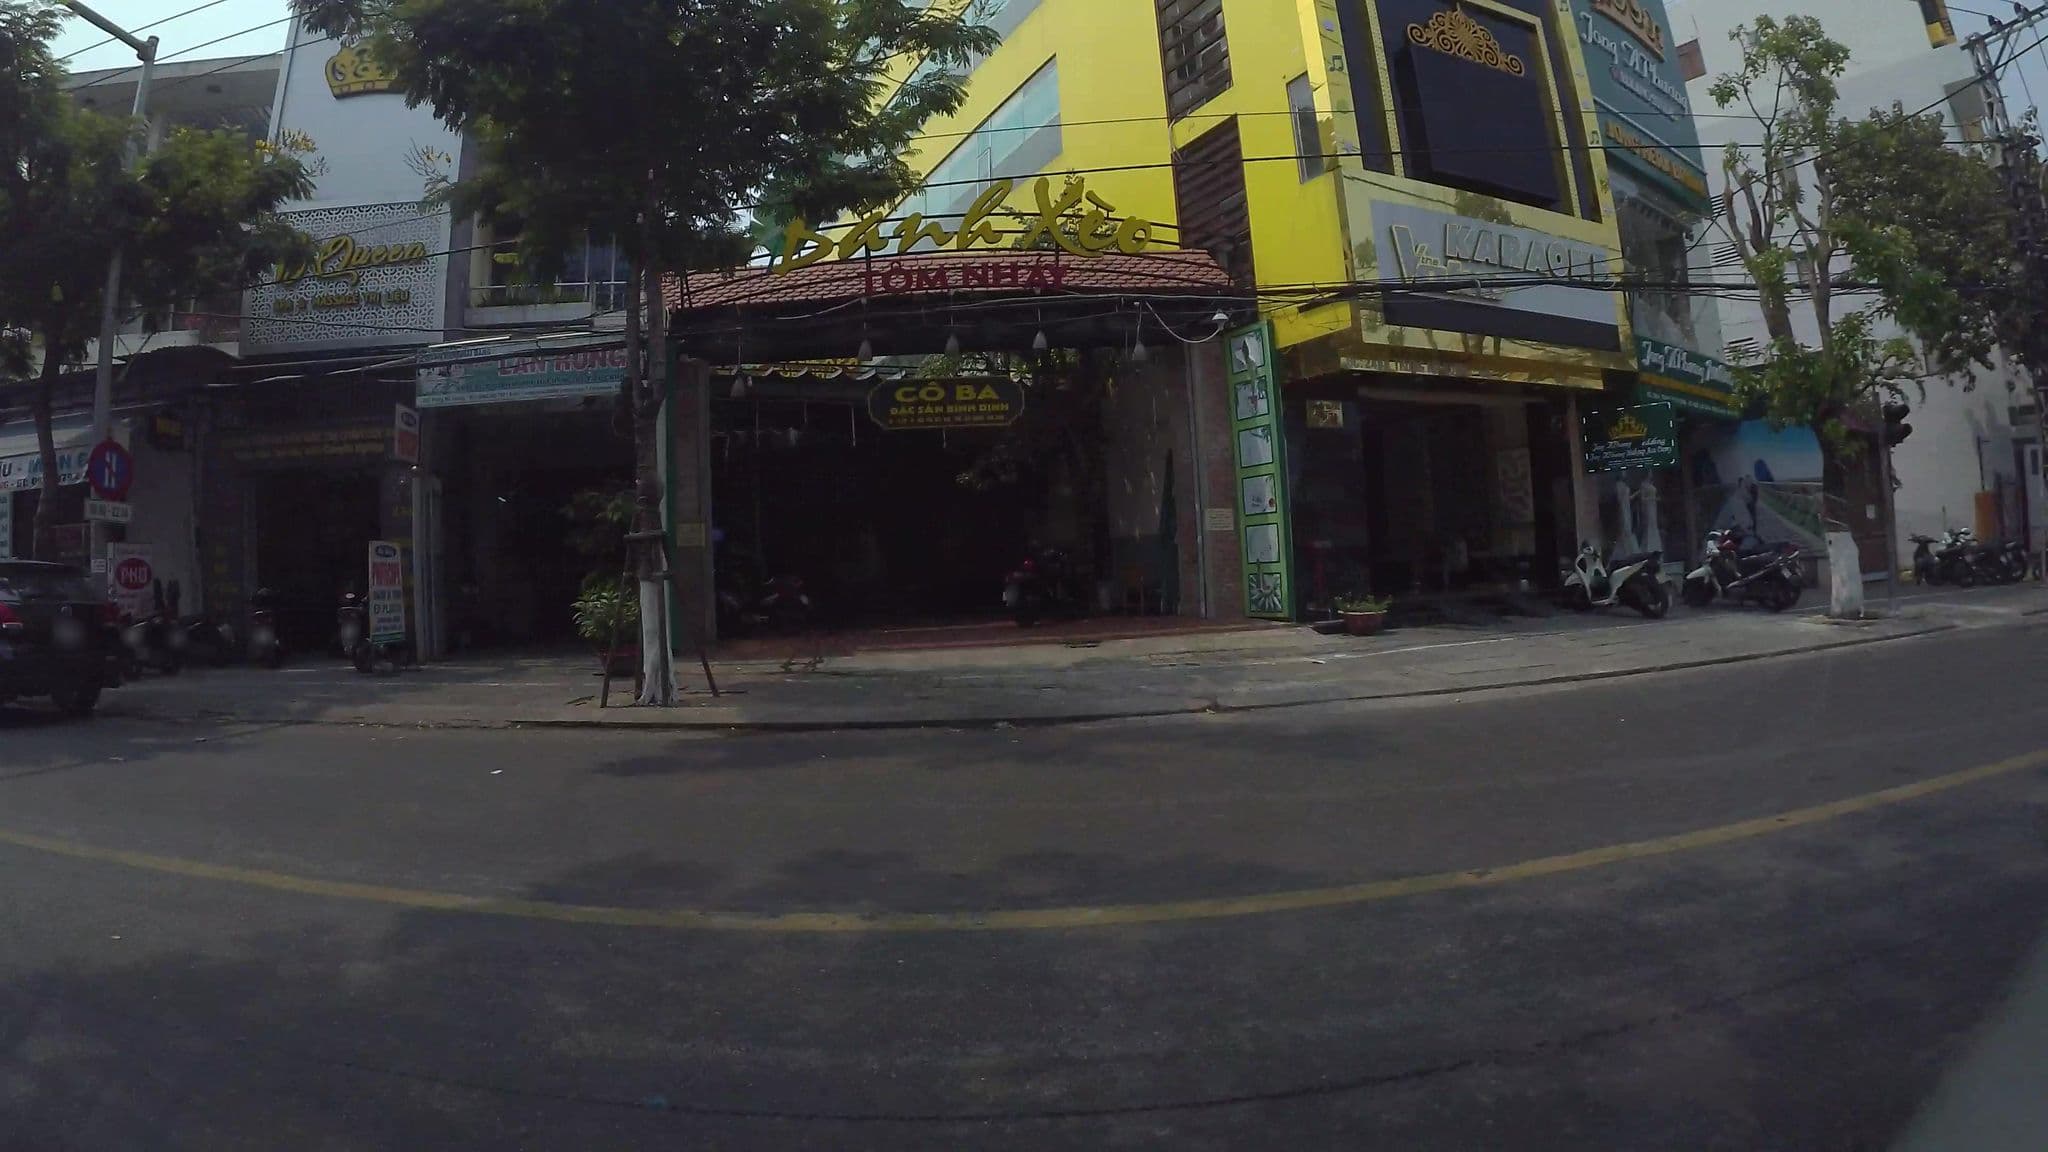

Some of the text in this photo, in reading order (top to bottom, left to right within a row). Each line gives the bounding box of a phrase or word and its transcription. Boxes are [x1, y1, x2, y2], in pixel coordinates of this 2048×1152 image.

[1022, 176, 1152, 258] Xèo
[315, 235, 426, 287] Queen
[1446, 223, 1610, 282] KARAO
[497, 356, 549, 377] LAN
[894, 381, 1000, 403] CÔ BA
